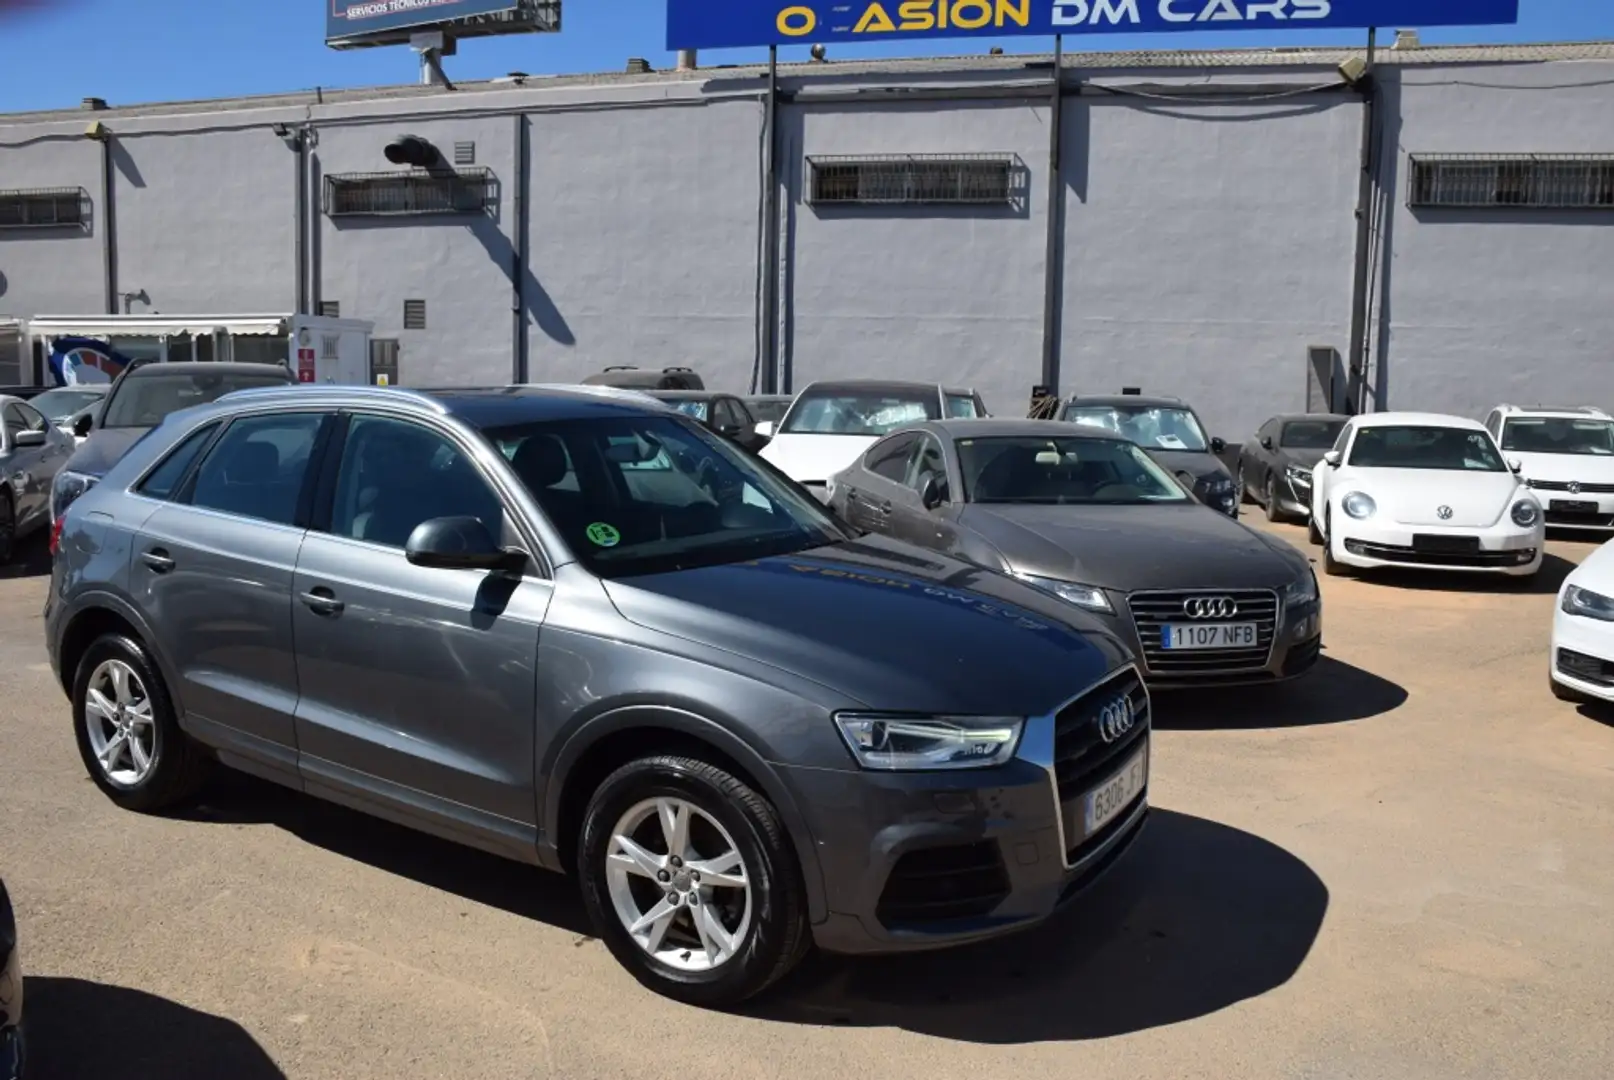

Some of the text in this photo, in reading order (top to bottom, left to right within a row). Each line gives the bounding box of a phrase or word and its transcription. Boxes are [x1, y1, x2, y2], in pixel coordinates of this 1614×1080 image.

[347, 3, 388, 19] SERVICIOS
[776, 0, 1331, 36] OASION DM CARS
[1176, 625, 1253, 645] 1107 NFB
